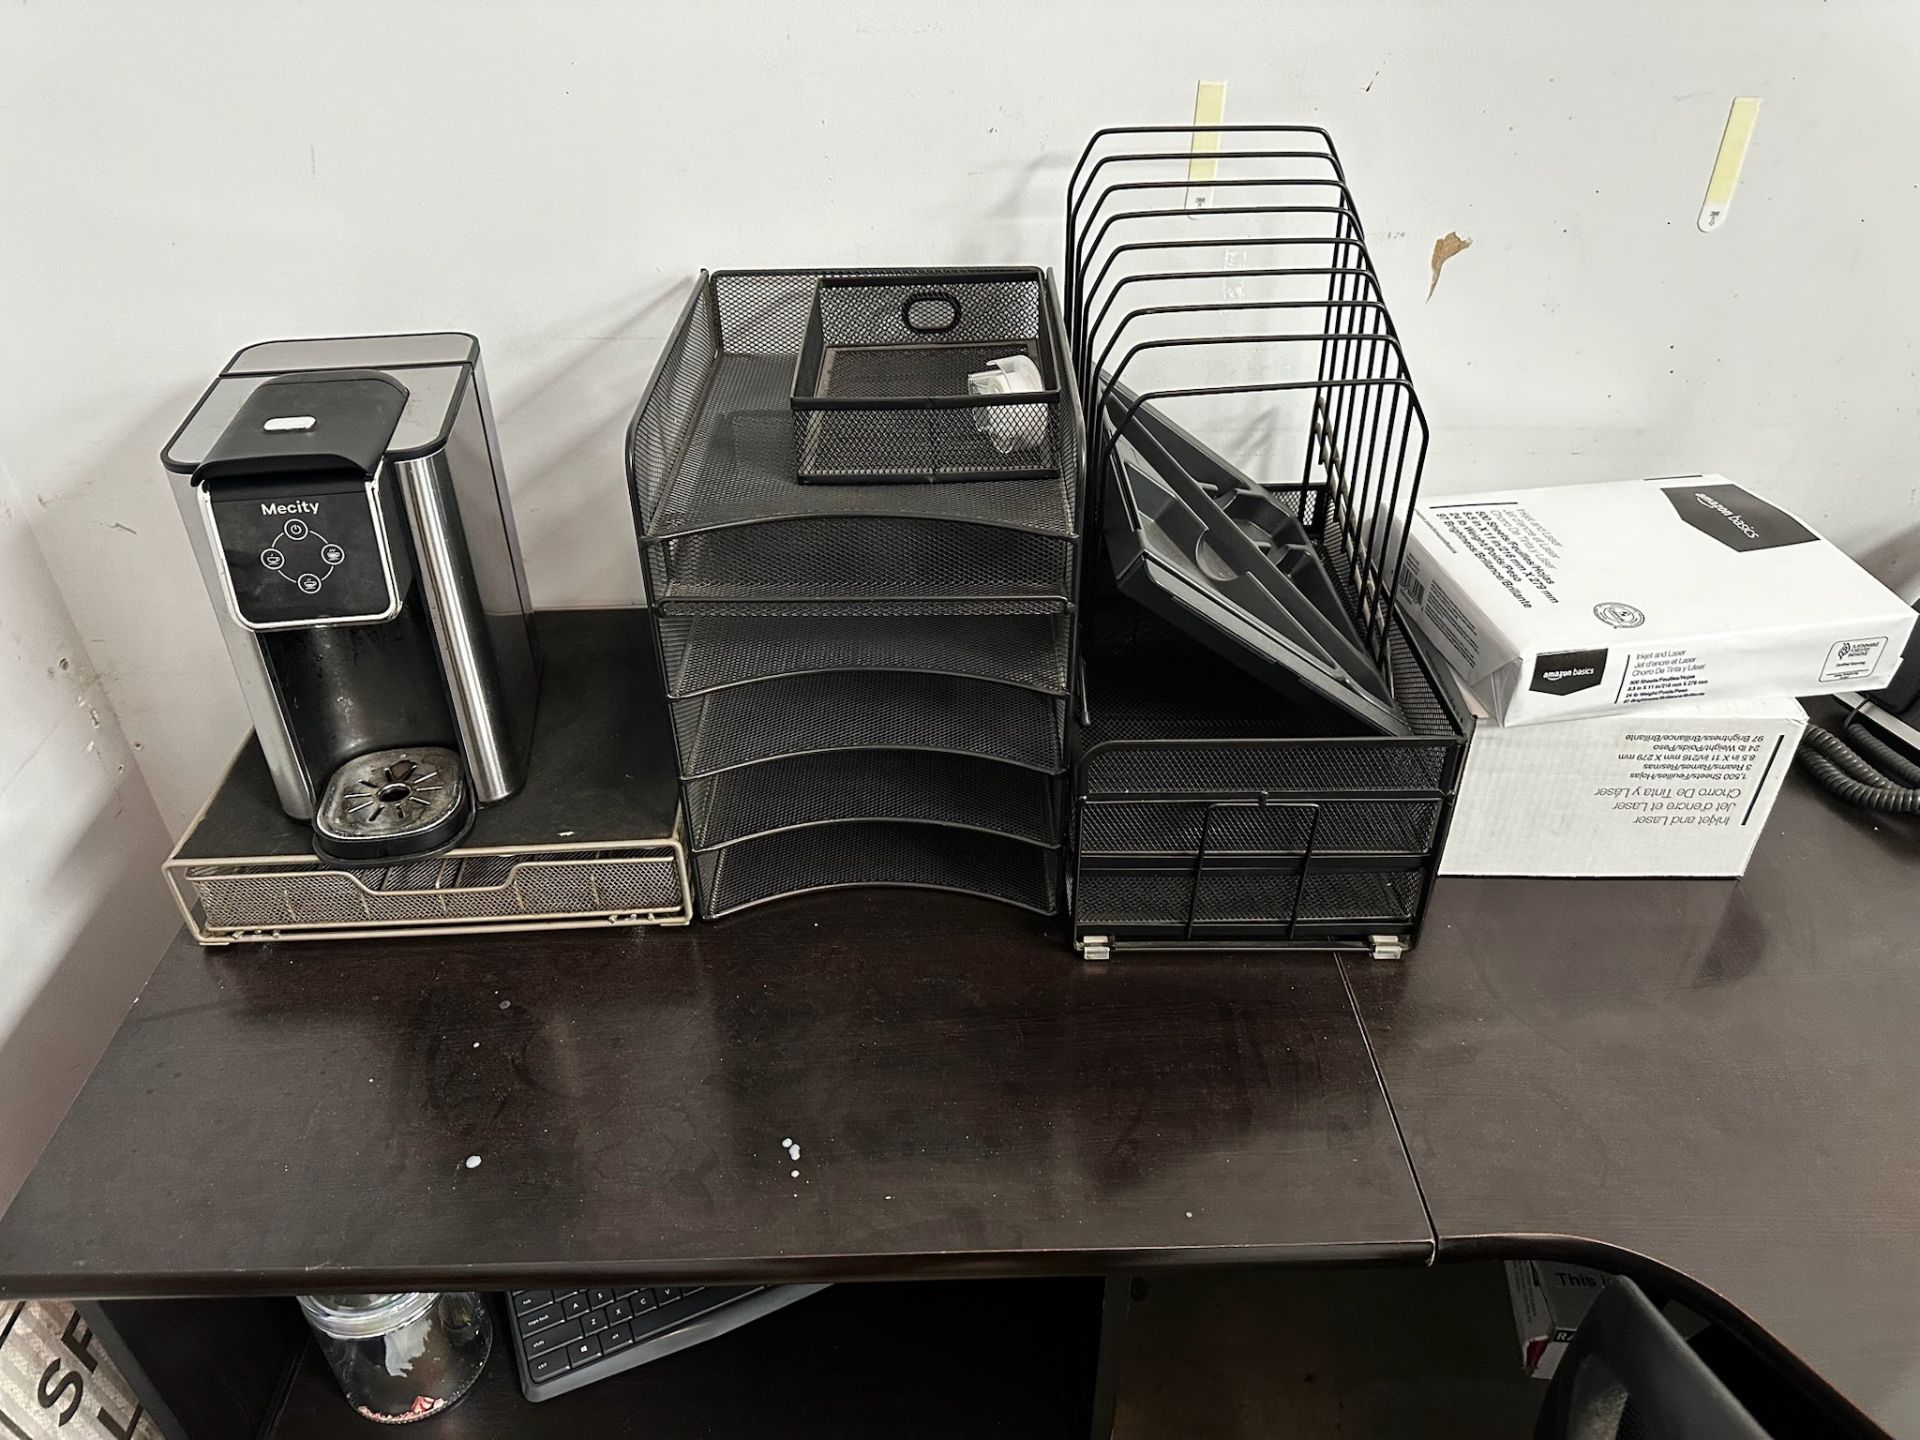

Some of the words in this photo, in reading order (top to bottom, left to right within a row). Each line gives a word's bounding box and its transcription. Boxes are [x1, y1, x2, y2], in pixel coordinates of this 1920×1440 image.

[261, 500, 320, 515] Mecity
[1695, 493, 1733, 516] amazon
[1728, 515, 1759, 539] basics
[1529, 577, 1547, 590] 279
[1541, 590, 1559, 603] mm
[1543, 669, 1572, 680] amazon
[1573, 667, 1594, 676] basics
[1625, 734, 1751, 743] Brightness/Brillance/Brillante
[1653, 744, 1736, 752] Weight/Poids/Peso
[1750, 744, 1761, 752] 24
[1643, 763, 1745, 771] Reams/Rames/Resmas
[1629, 772, 1722, 780] Sheets/Feuilles/Hojas
[1594, 787, 1630, 799] Láser
[1632, 786, 1642, 796] y
[1643, 787, 1672, 798] Tinta
[1676, 788, 1695, 798] De
[1698, 788, 1741, 798] Chorro
[1612, 802, 1647, 812] Laser
[1650, 802, 1663, 812] et
[1666, 802, 1713, 812] d'encre
[1715, 802, 1737, 812] Jet
[1632, 815, 1668, 825] Laser
[1670, 815, 1695, 825] and
[1698, 815, 1730, 826] Inkjet
[1555, 1271, 1597, 1288] This
[639, 1297, 647, 1305] C
